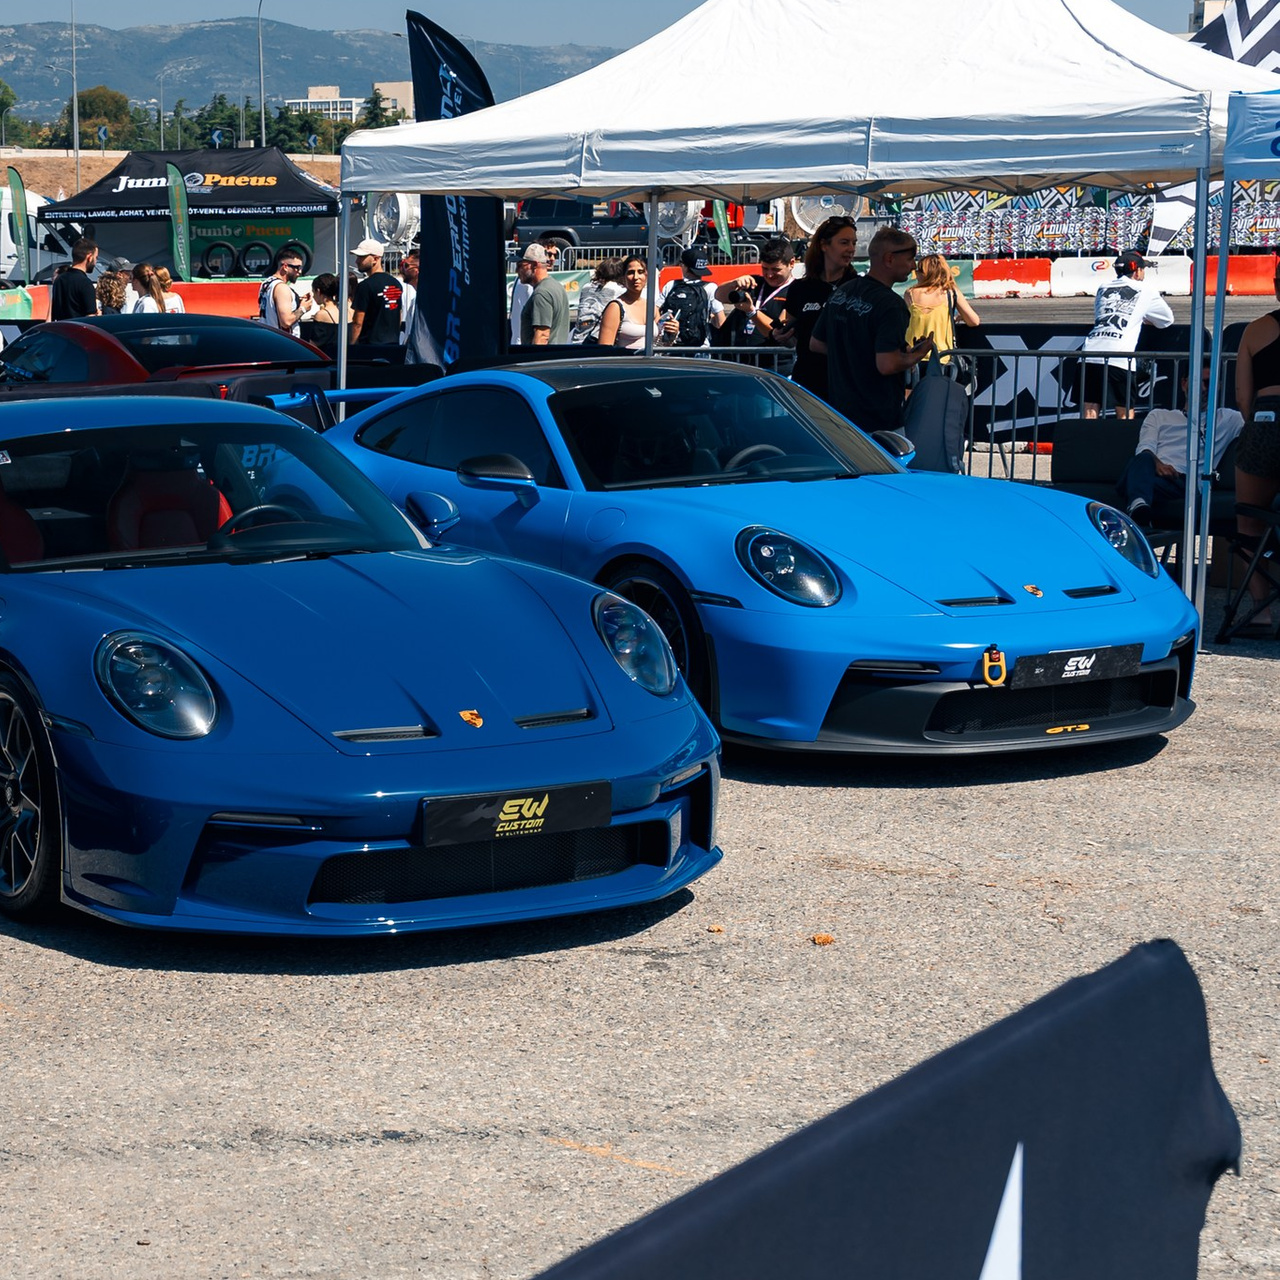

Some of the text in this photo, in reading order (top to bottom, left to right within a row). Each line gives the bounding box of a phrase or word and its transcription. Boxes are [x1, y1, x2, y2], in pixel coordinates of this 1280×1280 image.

[203, 173, 277, 187] Pneus
[119, 209, 145, 217] ACHAT,
[146, 208, 172, 216] VENTE,
[227, 205, 274, 214] DÉPANNAGE,
[276, 205, 328, 213] REMORQUAGE
[1025, 222, 1082, 236] VIP LOUNGE
[1238, 218, 1252, 229] VIP
[245, 225, 292, 236] Pneus
[922, 224, 977, 239] VIP LOUNGE
[1061, 669, 1091, 678] CUSTOM
[1045, 724, 1090, 734] GT3
[496, 818, 545, 832] CUSTOM
